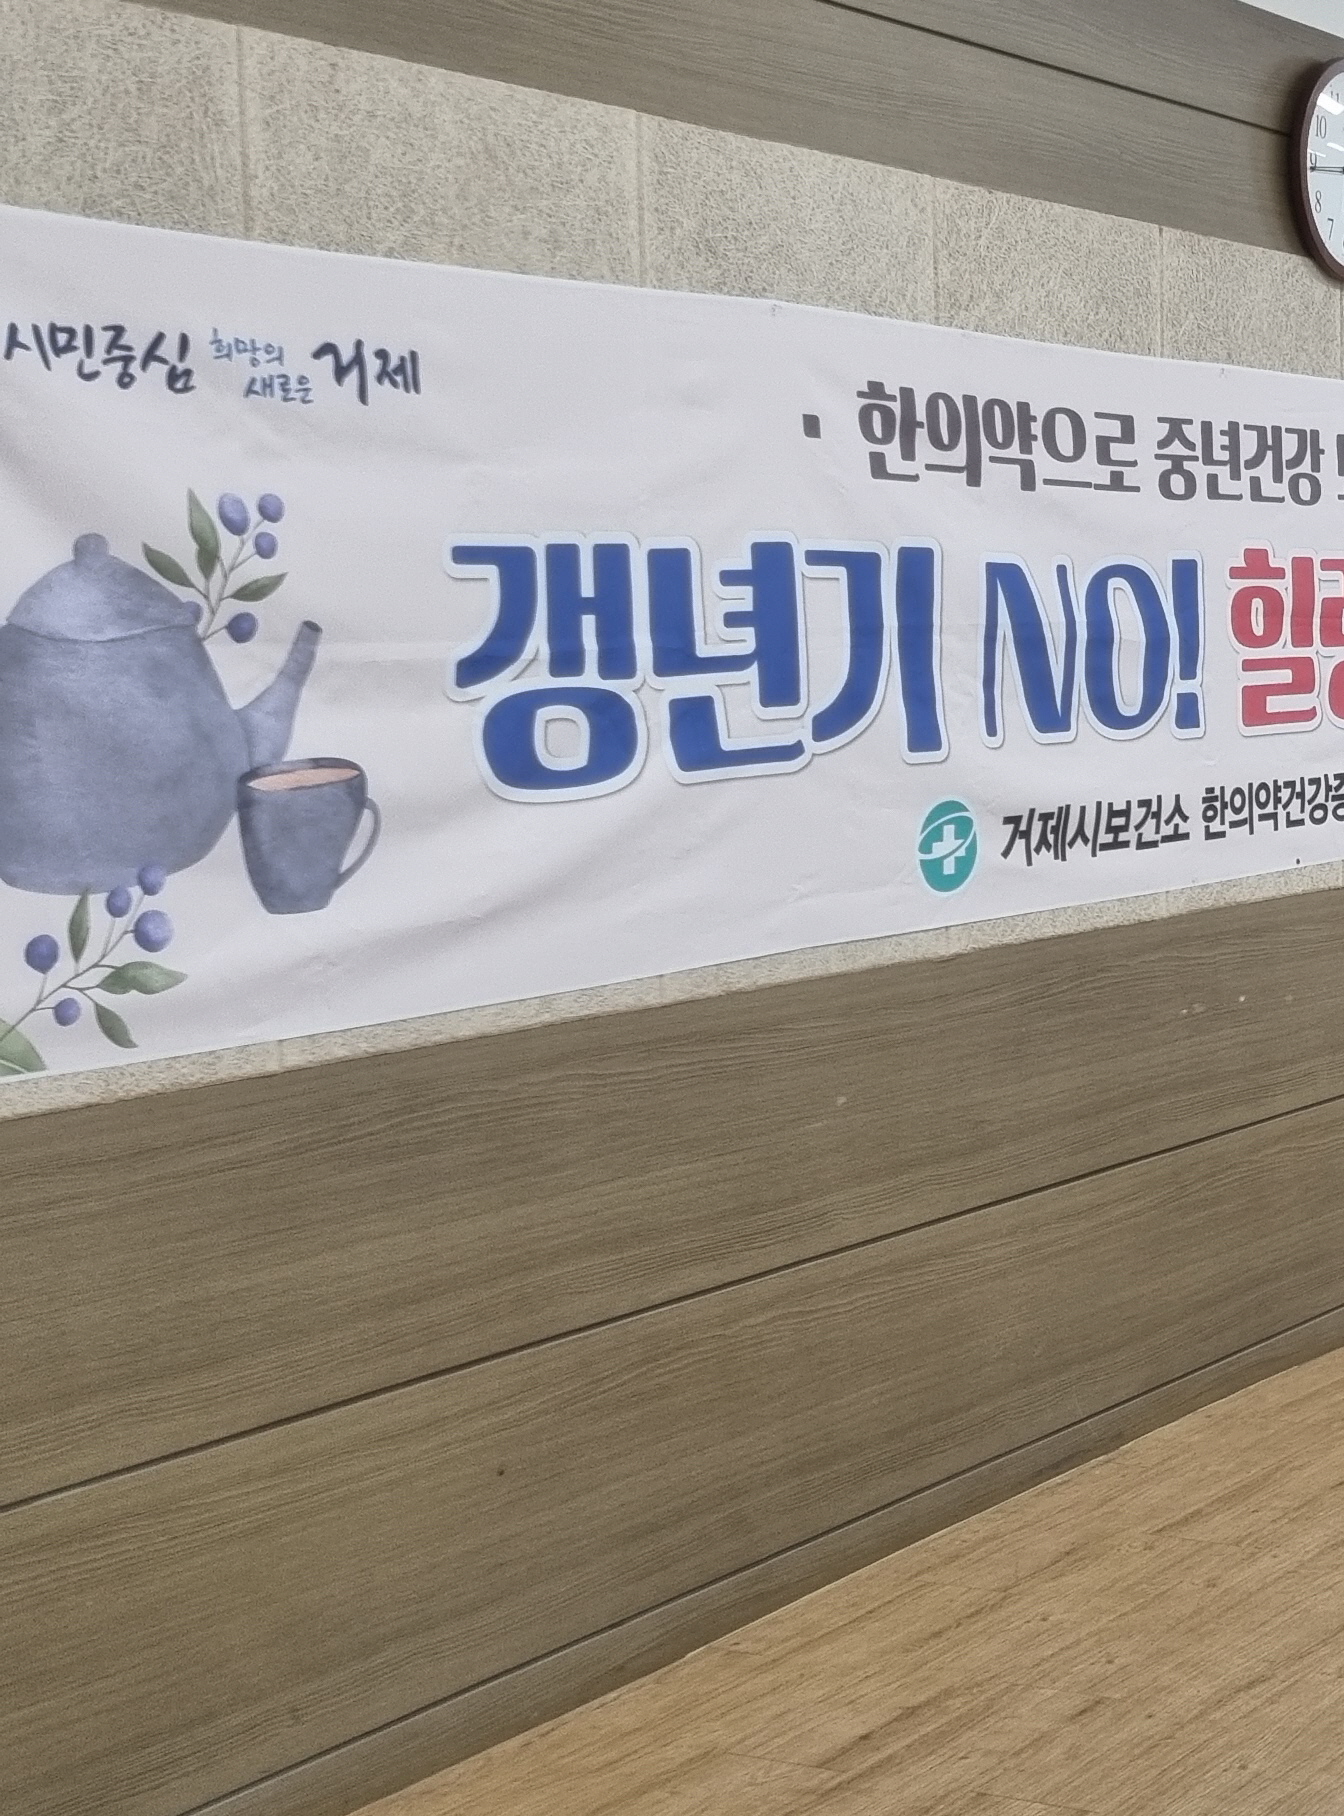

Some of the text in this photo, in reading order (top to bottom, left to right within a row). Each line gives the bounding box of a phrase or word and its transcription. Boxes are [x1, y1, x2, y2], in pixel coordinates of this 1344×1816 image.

[1315, 115, 1327, 138] 10
[1315, 191, 1322, 213] 8
[1327, 218, 1335, 240] 7
[3, 322, 198, 394] 시민중심
[209, 327, 285, 367] 희망의
[311, 338, 421, 406] 거제
[243, 373, 314, 404] 새로운
[856, 380, 1141, 495] 한의약으로
[1154, 415, 1325, 508] 중년건강
[450, 540, 942, 791] 갱년기
[983, 557, 1199, 738] NO!
[1000, 798, 1190, 868] 거제시보건소
